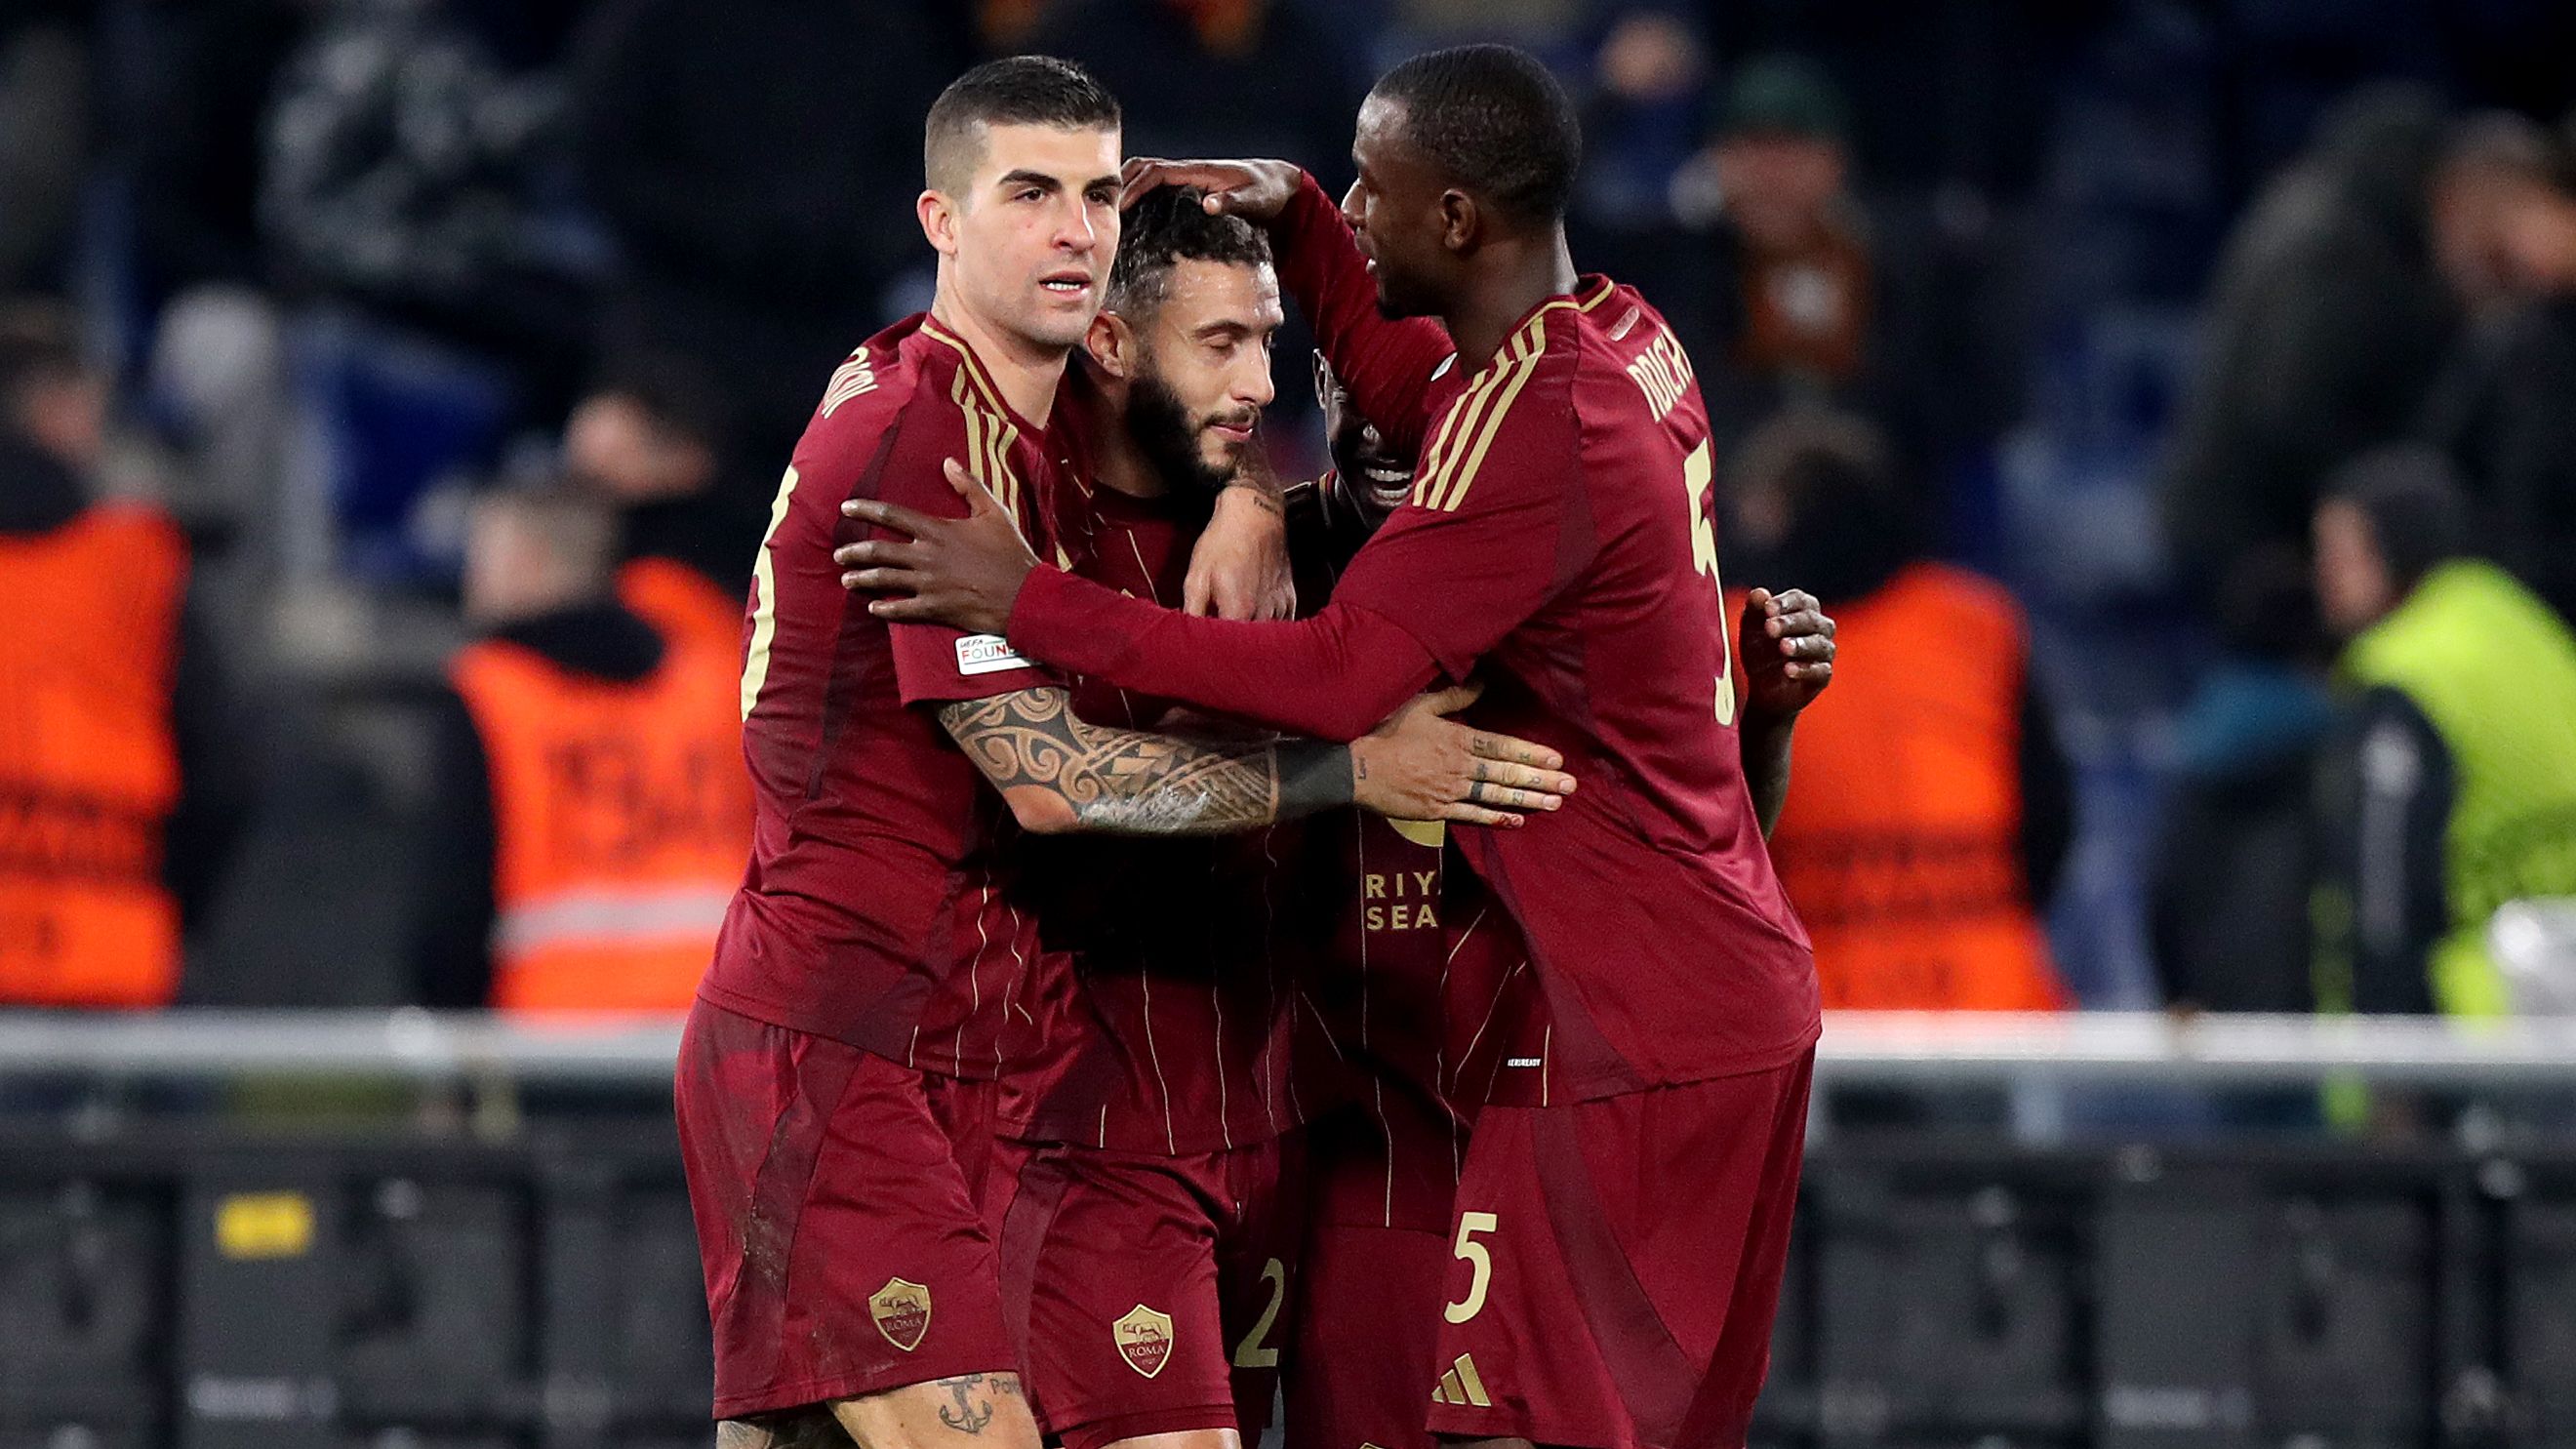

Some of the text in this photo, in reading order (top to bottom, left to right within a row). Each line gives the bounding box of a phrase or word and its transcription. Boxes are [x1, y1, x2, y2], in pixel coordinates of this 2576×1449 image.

[1366, 870, 1441, 898] RIY
[1366, 904, 1438, 930] SEA
[1444, 1211, 1498, 1324] 5
[1233, 1257, 1285, 1368] 2
[1129, 1345, 1166, 1358] ROMA
